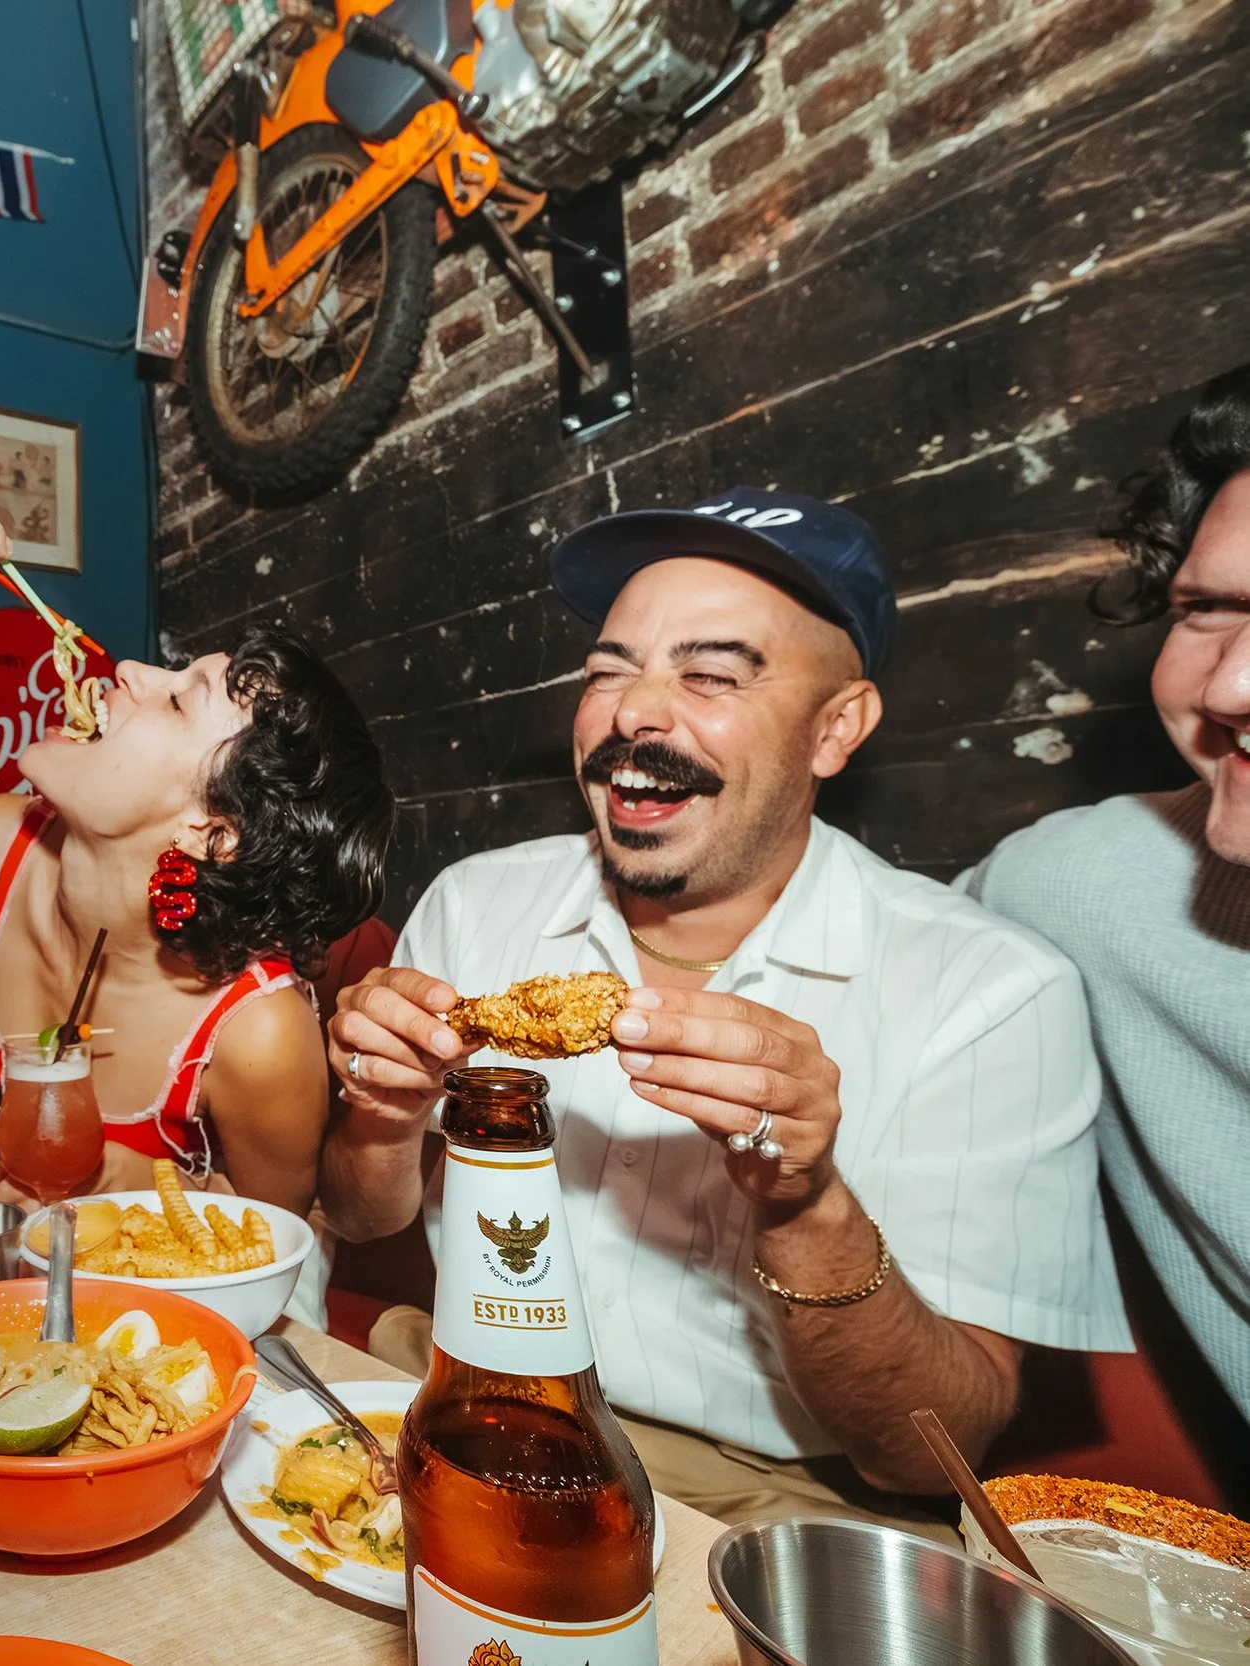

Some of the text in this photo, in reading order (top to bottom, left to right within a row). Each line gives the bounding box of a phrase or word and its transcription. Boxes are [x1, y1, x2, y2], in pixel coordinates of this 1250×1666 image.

[482, 1253, 552, 1288] BY ROYAL PERMISSION
[474, 1301, 566, 1323] ESTD 1933
